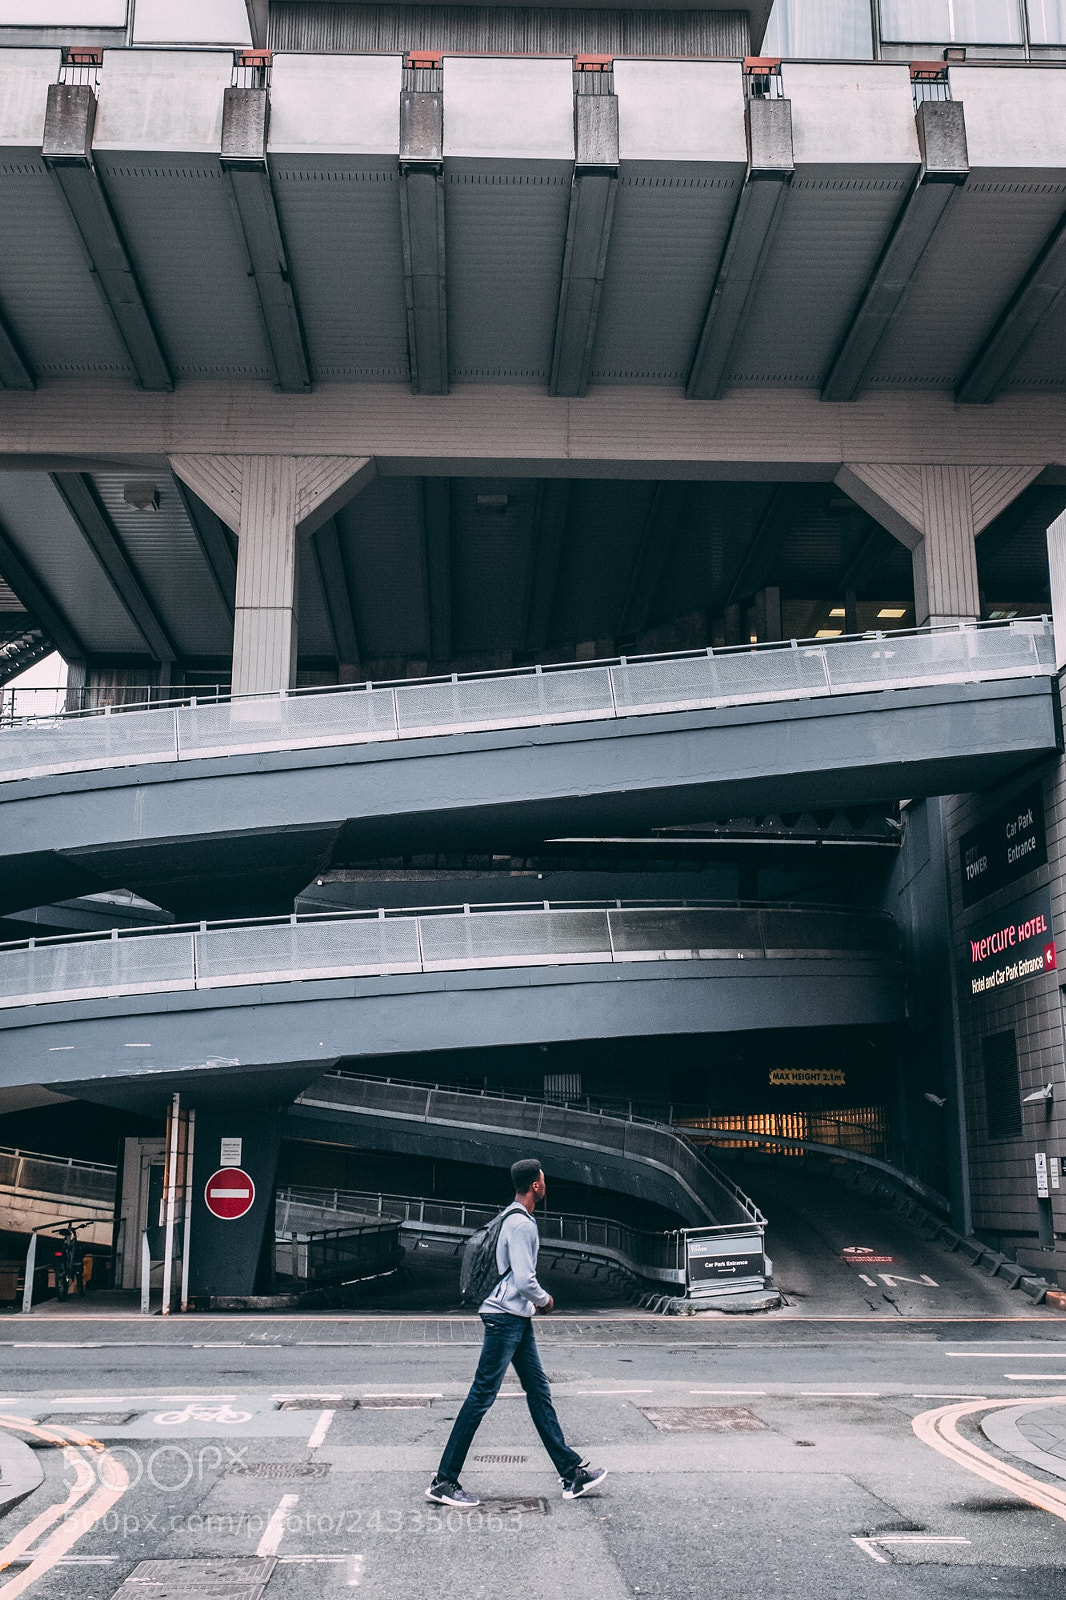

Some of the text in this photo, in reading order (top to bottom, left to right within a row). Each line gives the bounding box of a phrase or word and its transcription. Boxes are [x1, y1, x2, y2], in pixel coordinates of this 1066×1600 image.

[1006, 808, 1033, 839] Car Park
[1007, 836, 1036, 864] Entrance
[965, 855, 988, 881] TOWER
[1018, 914, 1048, 943] HOTEL
[971, 955, 1044, 995] Hotel and Car Park Entrance
[772, 1072, 842, 1082] MAX HEIGHT 2.1m
[858, 1273, 940, 1288] IN
